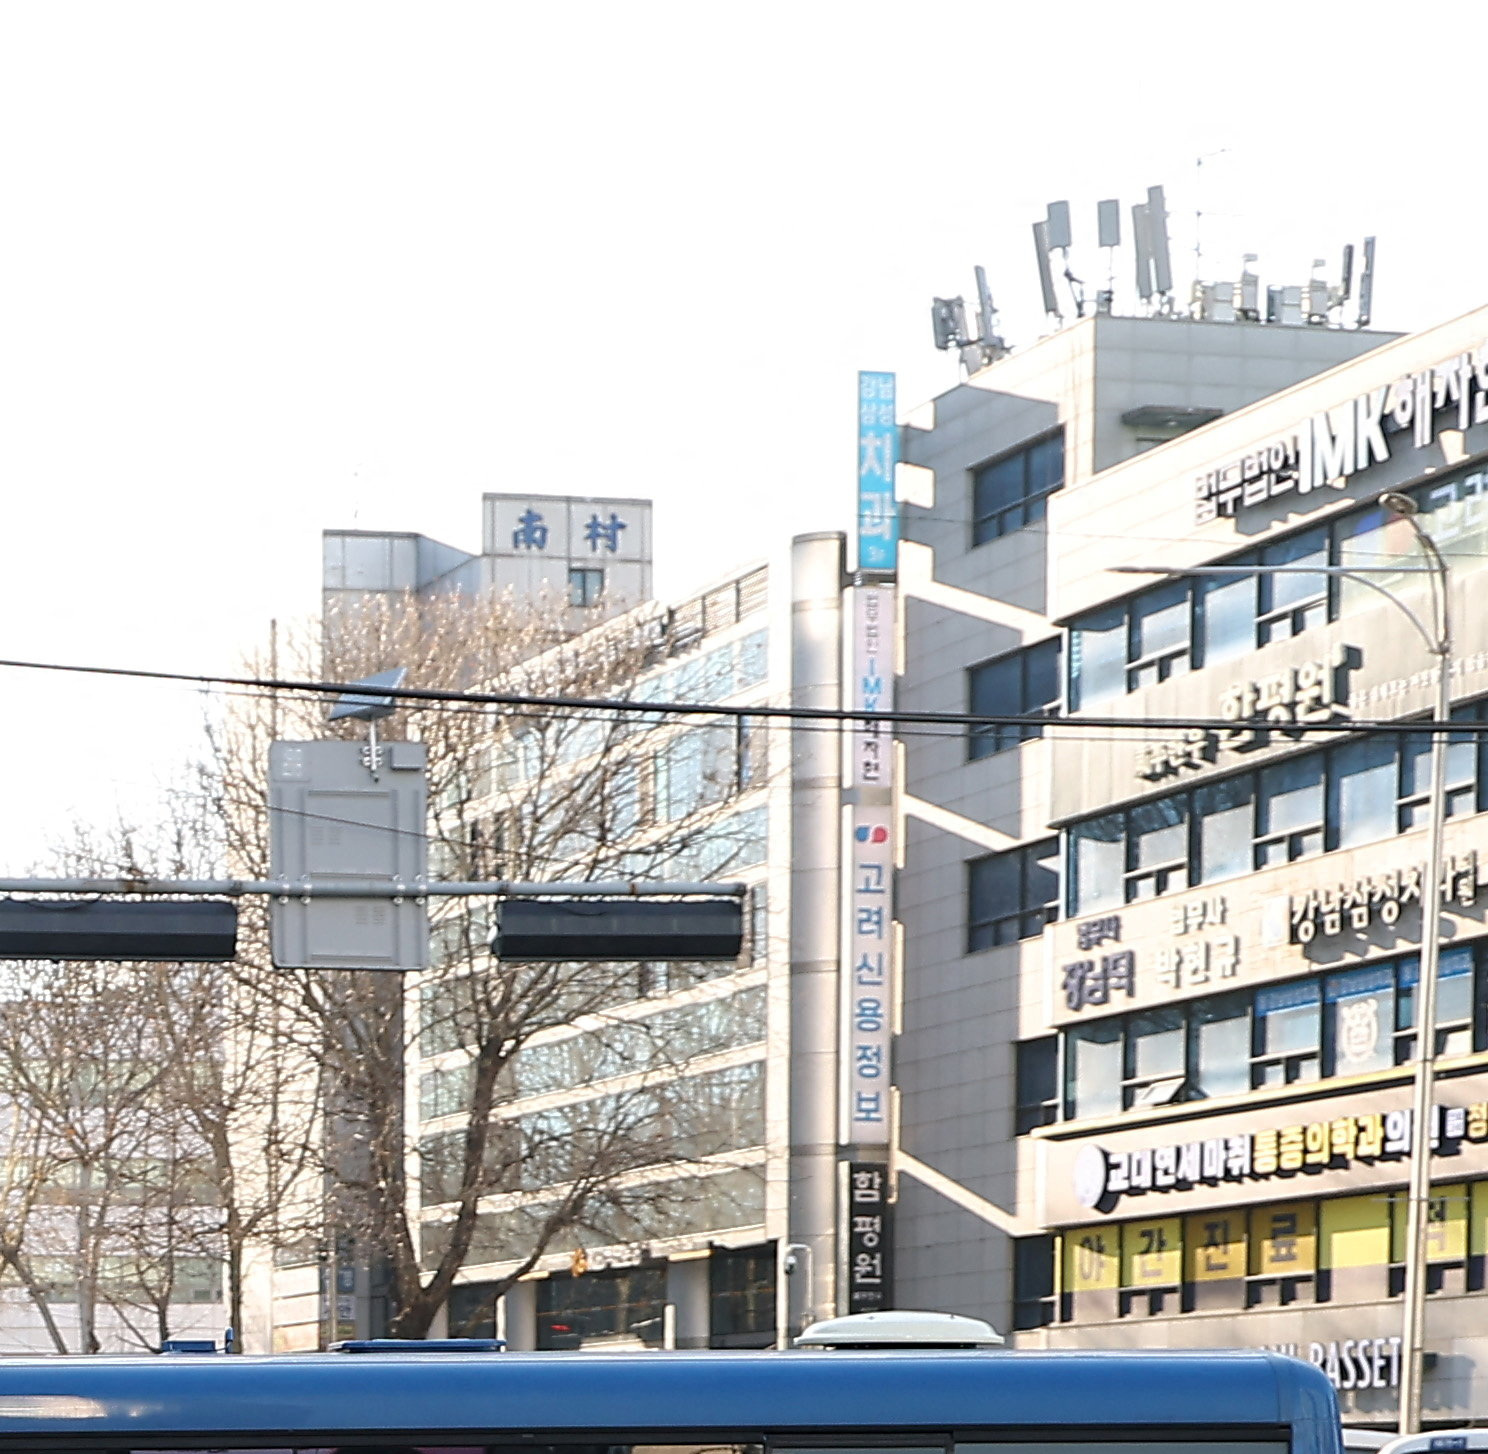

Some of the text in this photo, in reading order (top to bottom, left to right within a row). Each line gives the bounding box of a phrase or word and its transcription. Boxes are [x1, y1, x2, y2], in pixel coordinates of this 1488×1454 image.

[861, 432, 895, 540] 치과
[854, 864, 885, 1123] 고려신용정보
[853, 1171, 882, 1284] 함평원
